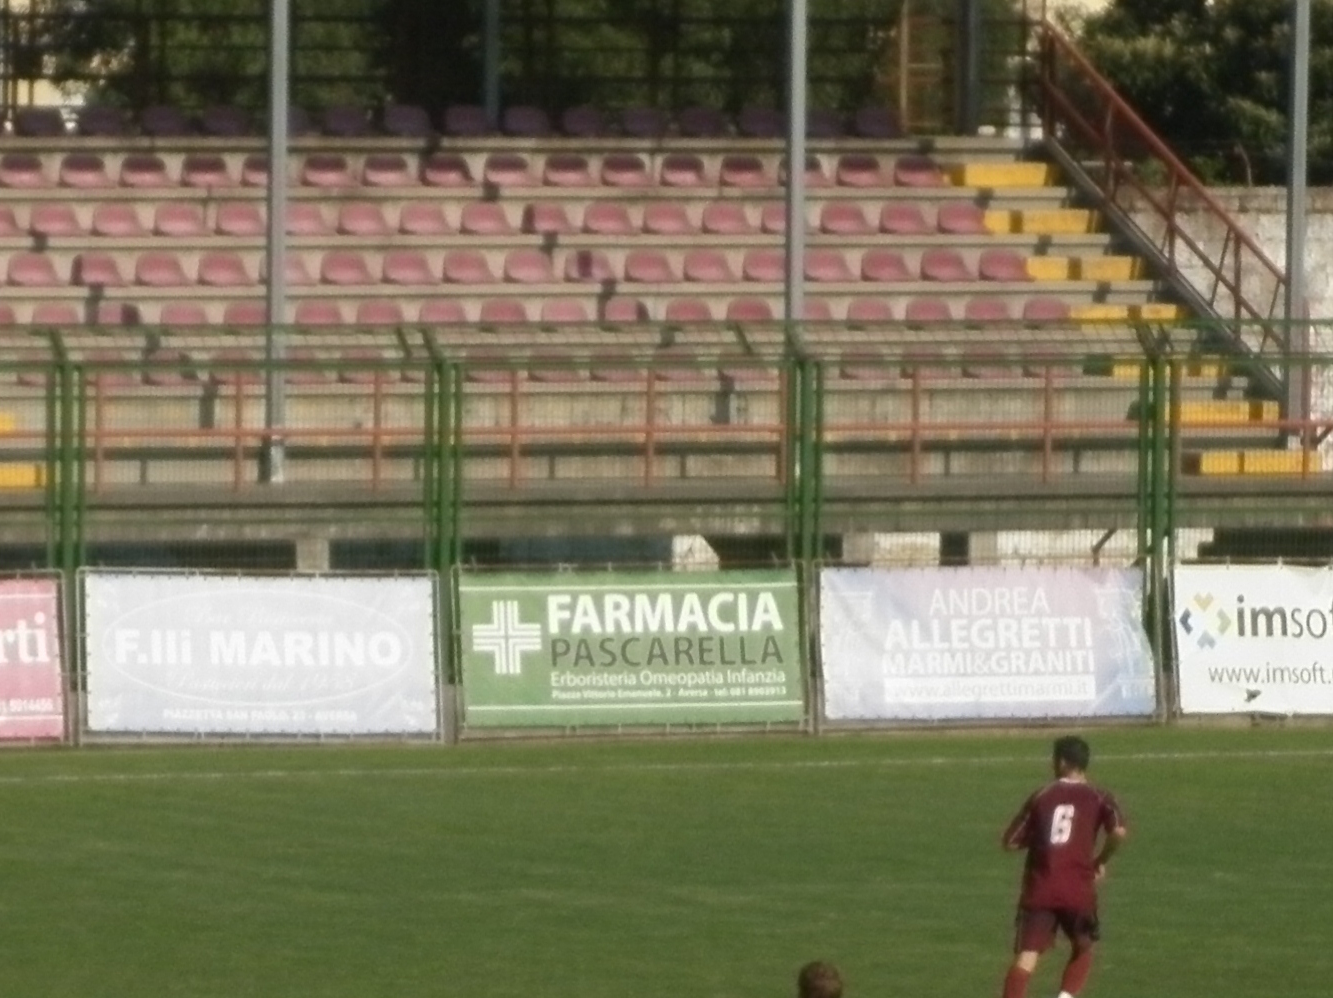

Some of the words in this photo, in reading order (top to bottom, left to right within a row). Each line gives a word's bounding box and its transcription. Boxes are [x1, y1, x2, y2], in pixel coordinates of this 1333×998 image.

[547, 592, 784, 633] FARMACIA
[929, 586, 1050, 616] ANDREA
[1236, 594, 1333, 639] imso
[209, 630, 403, 666] MARINO
[884, 617, 1093, 650] ALLEGRETTI
[551, 635, 784, 667] PASCARELLA
[881, 650, 1095, 675] MARMI&GRANITI
[550, 671, 637, 687] Erboristeria
[640, 669, 724, 688] Omeopatia
[727, 668, 786, 684] Infanzia
[1049, 804, 1075, 844] 6
